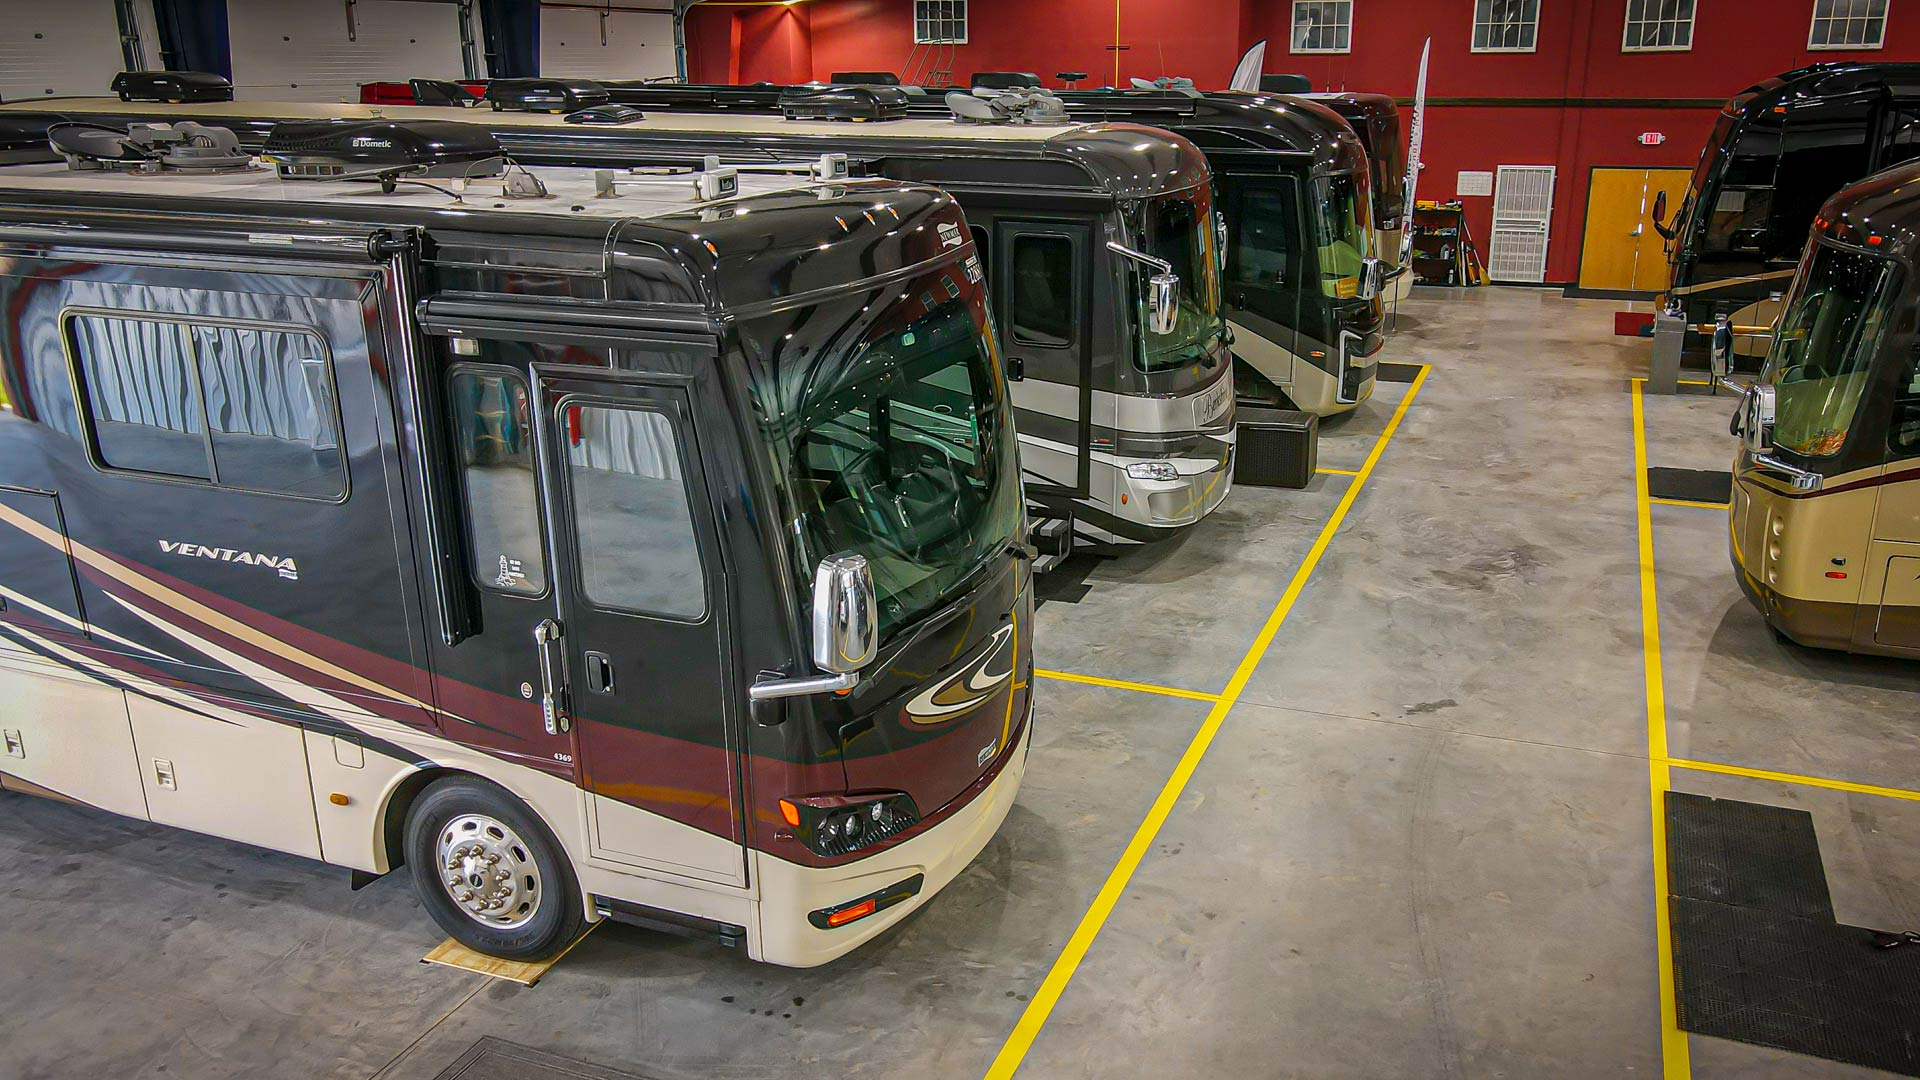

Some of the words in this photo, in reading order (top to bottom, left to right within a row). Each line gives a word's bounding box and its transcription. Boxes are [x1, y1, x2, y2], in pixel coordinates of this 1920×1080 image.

[360, 139, 392, 148] Dometic
[158, 539, 297, 571] VENTANA
[553, 752, 572, 762] 4369
